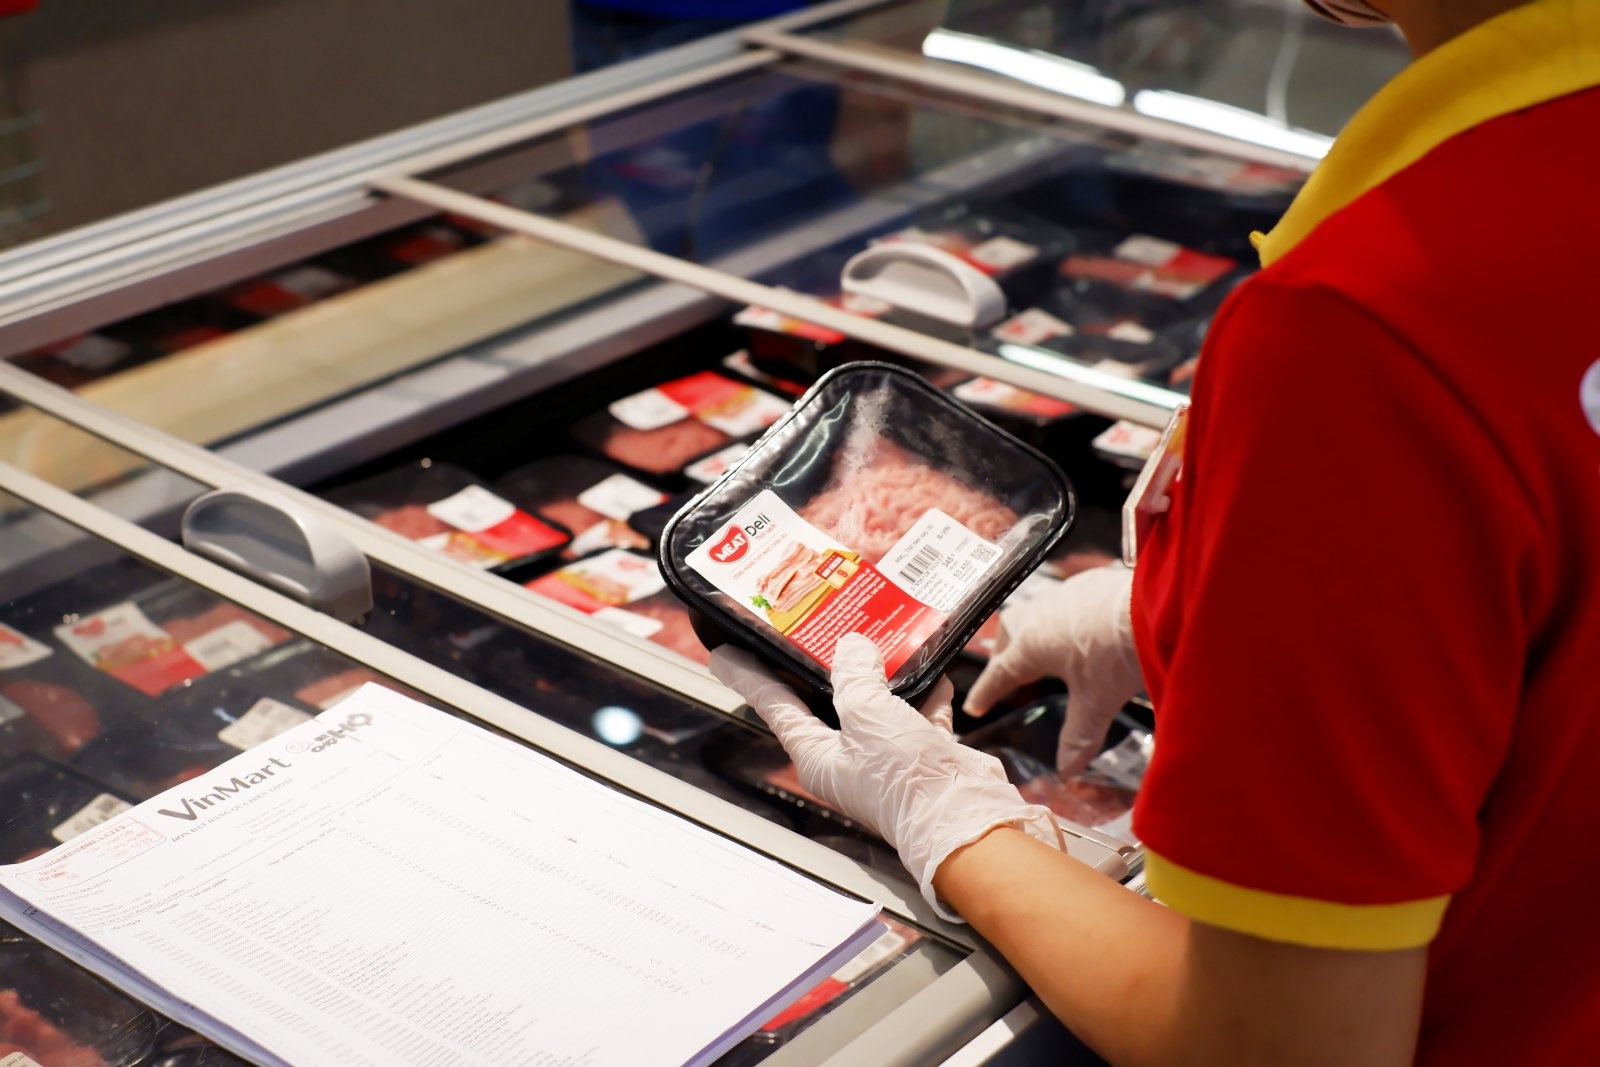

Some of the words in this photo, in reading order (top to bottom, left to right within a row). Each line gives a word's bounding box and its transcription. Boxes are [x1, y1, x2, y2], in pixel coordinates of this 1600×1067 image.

[714, 532, 747, 562] MEAT
[745, 512, 771, 537] Deli
[157, 757, 292, 821] VinMart
